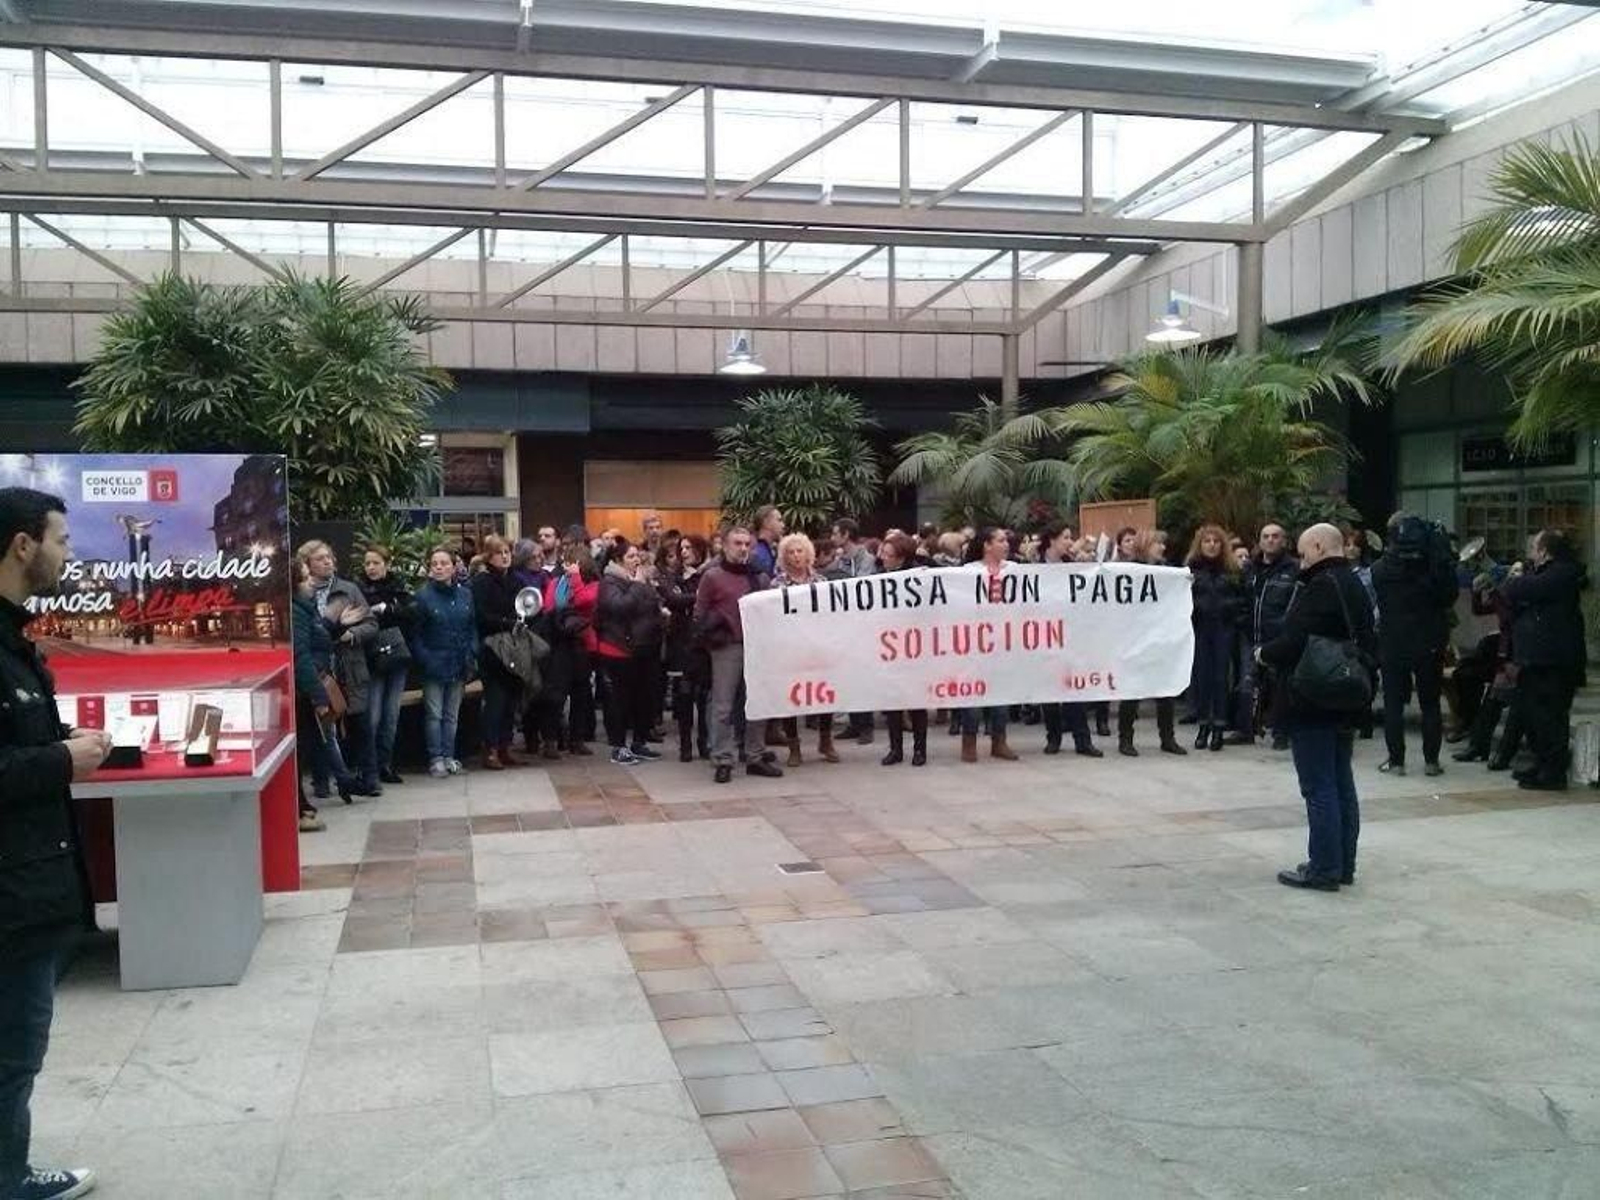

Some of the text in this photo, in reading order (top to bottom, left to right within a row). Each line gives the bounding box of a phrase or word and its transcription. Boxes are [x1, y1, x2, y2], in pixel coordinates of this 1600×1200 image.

[85, 477, 143, 486] CONCELLO
[92, 487, 137, 496] DE VIGO
[92, 552, 174, 581] nunha
[182, 549, 272, 580] cidade
[781, 573, 1160, 615] LINORSA NON PAGA
[880, 619, 1066, 662] SOLUCION
[790, 681, 835, 707] CIG
